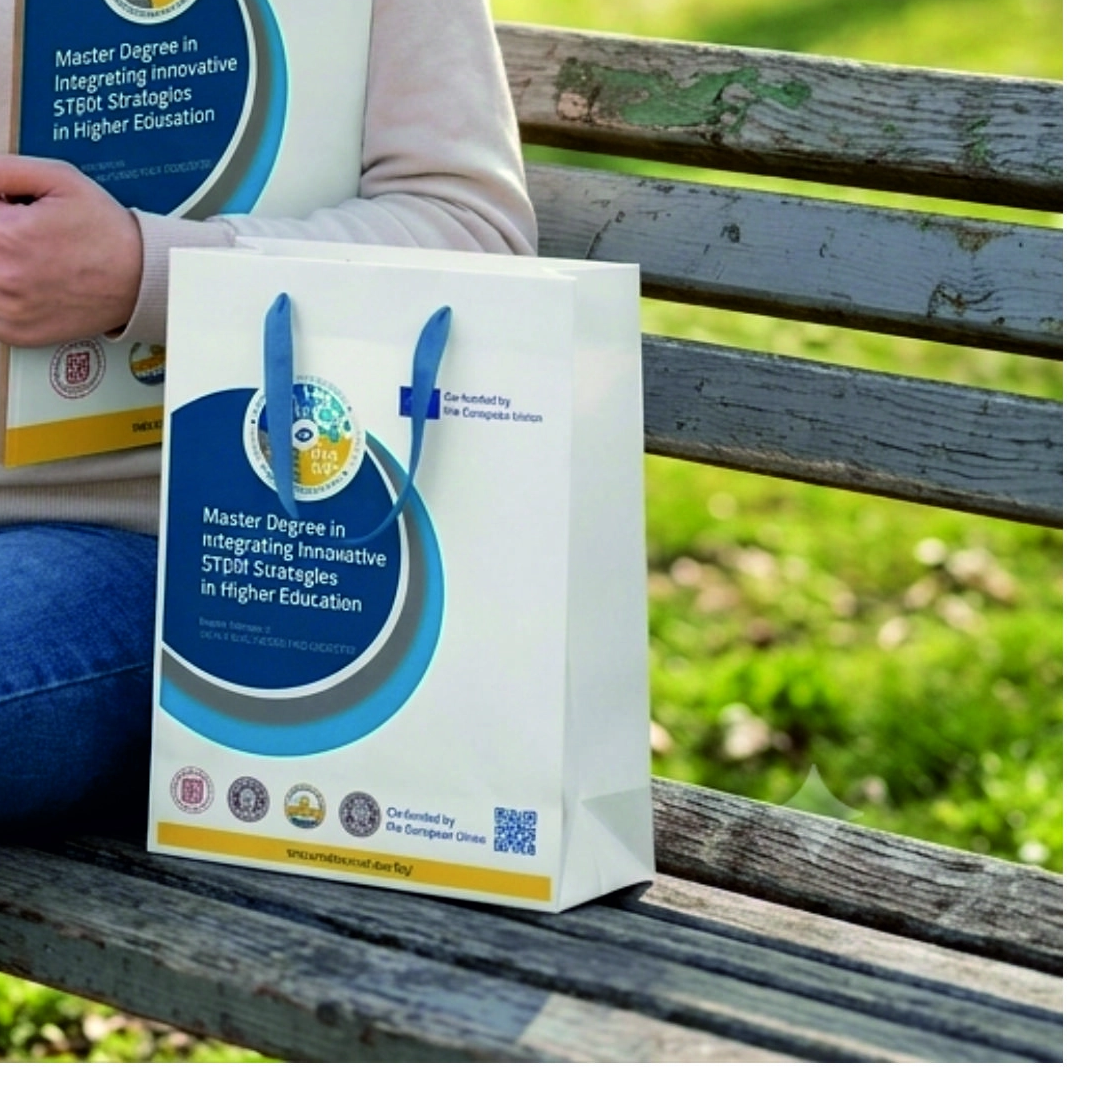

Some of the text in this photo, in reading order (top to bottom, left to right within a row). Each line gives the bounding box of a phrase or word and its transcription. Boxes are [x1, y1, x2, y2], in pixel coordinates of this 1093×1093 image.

[55, 47, 115, 67] Master
[182, 35, 198, 53] in
[53, 124, 69, 142] in
[73, 116, 130, 142] Higher
[203, 506, 346, 538] Master Degree in
[201, 578, 363, 613] in Higher Education
